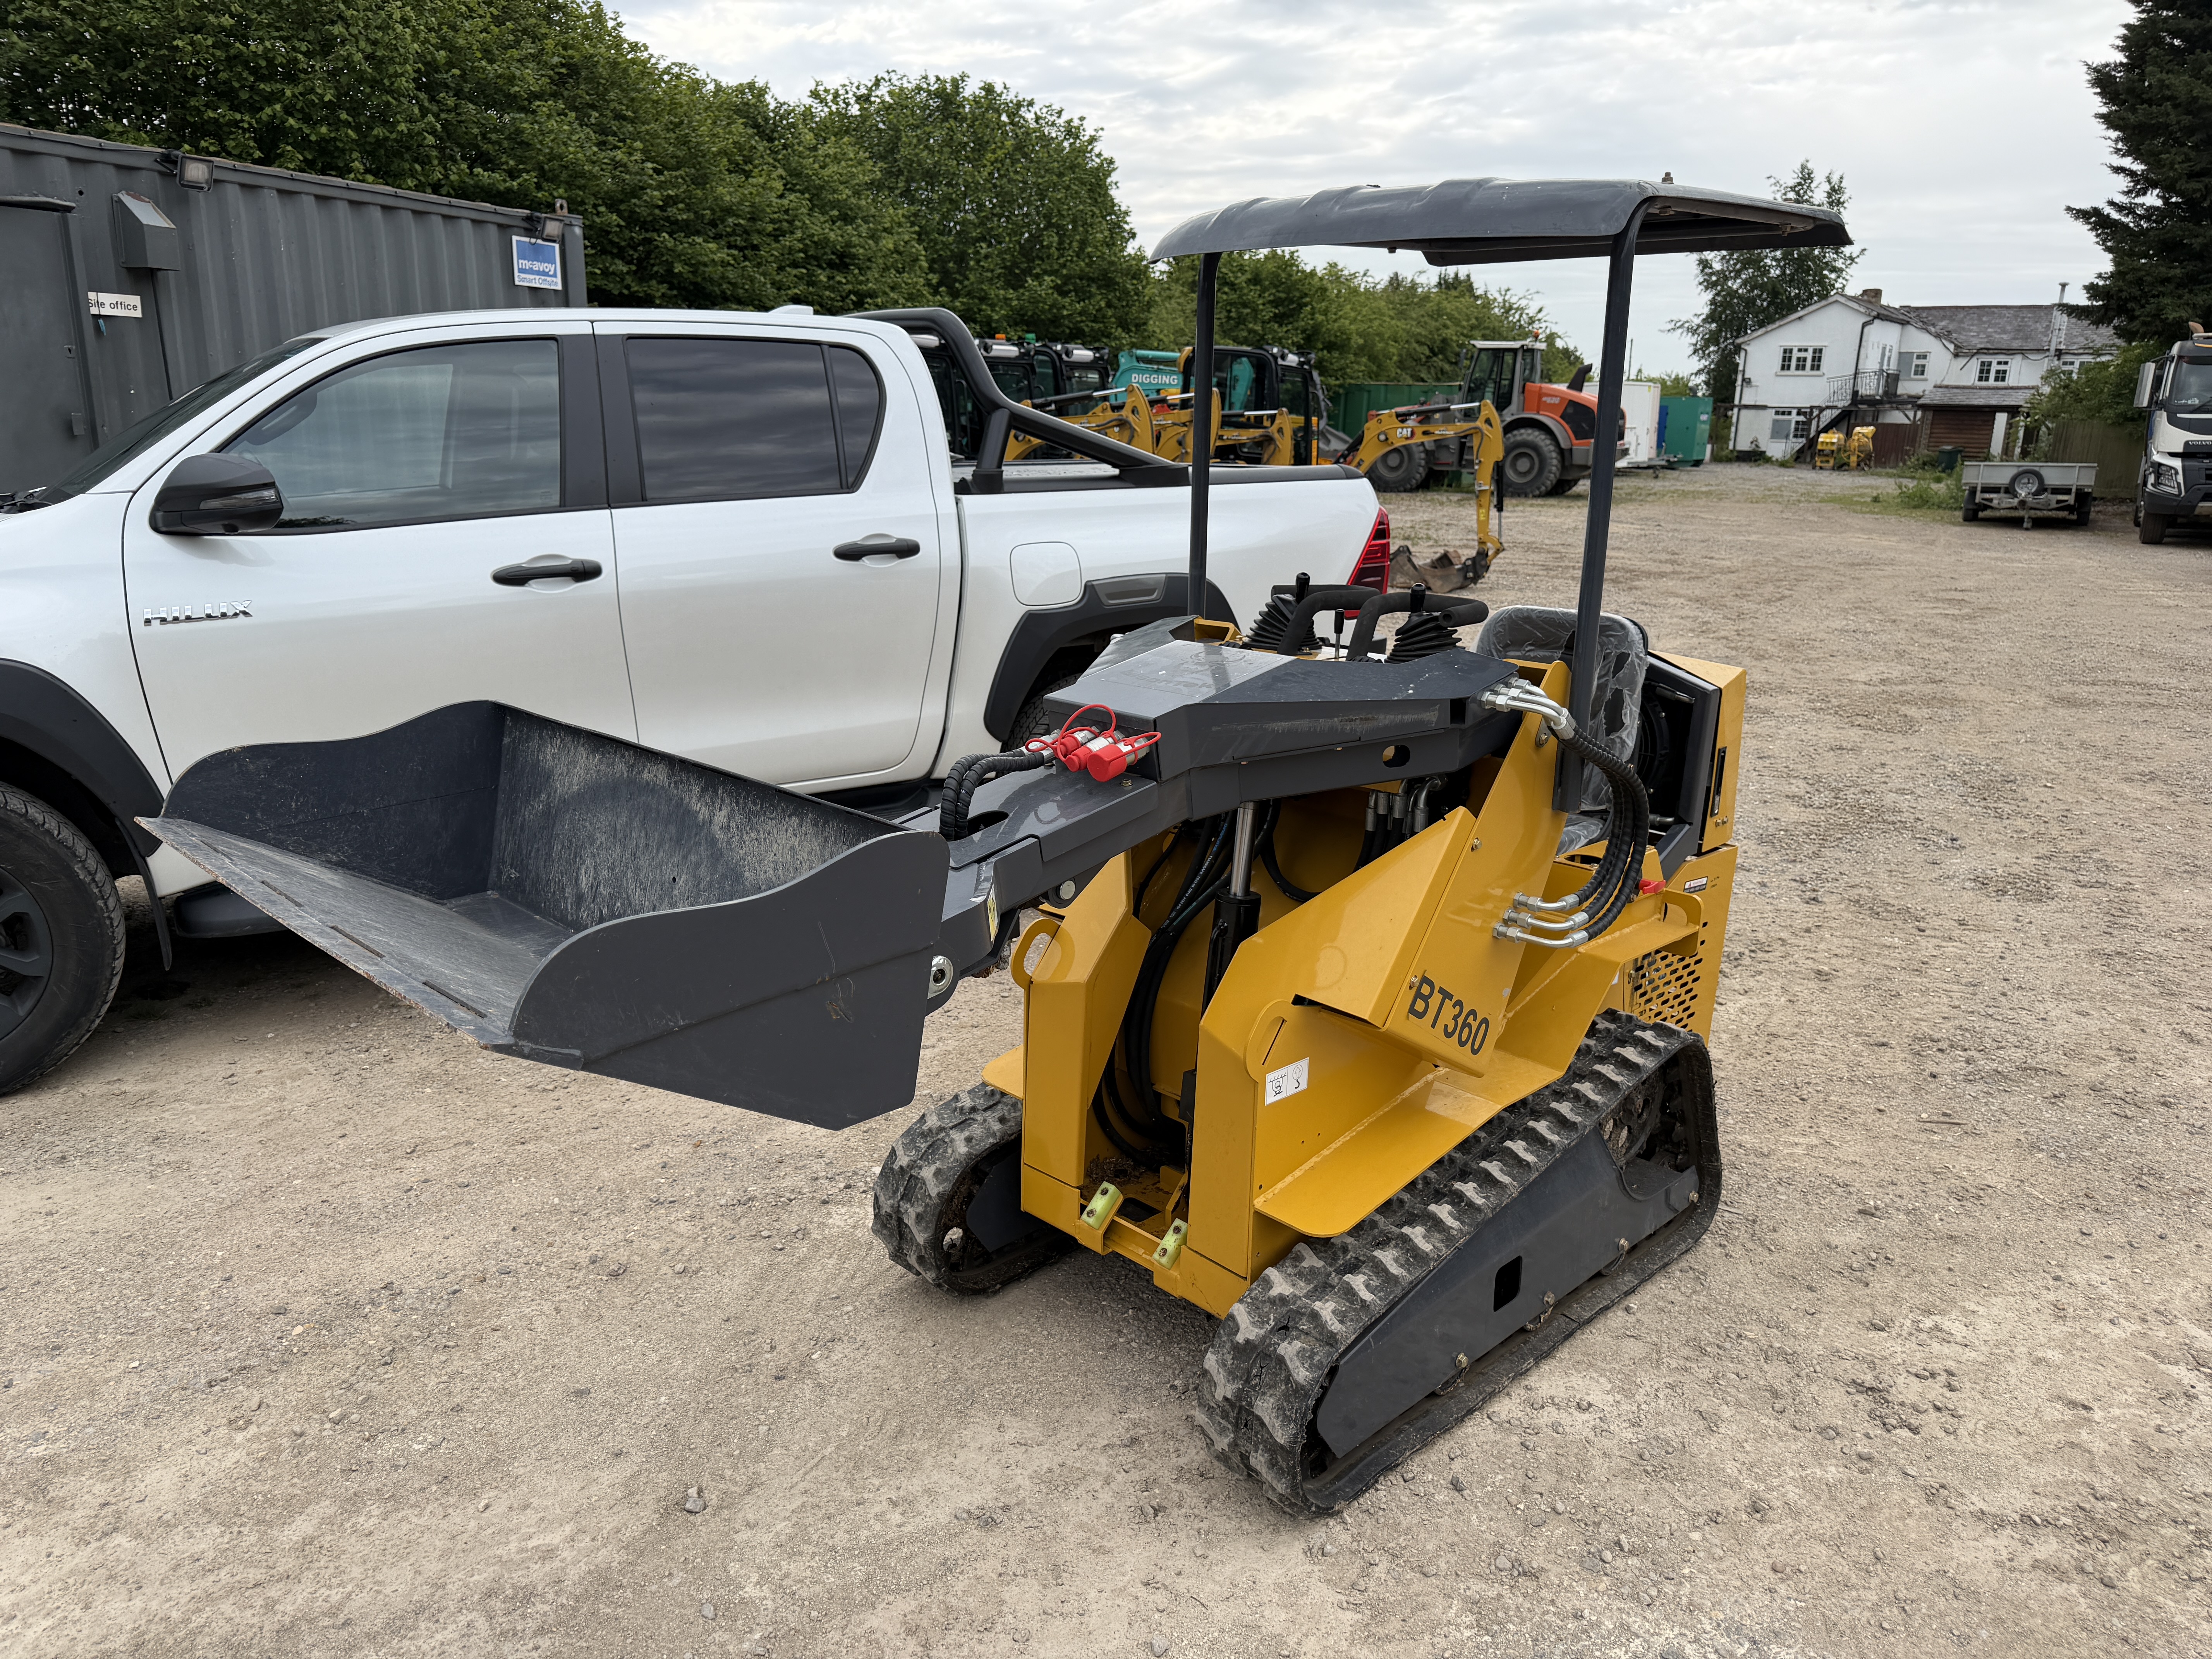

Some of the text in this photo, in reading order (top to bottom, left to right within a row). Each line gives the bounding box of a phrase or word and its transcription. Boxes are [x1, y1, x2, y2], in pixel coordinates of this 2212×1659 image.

[519, 259, 555, 275] mcavoy
[89, 299, 137, 311] Site office
[1132, 374, 1178, 385] DIGGING
[1396, 428, 1412, 438] CAT
[144, 600, 253, 626] HILUX
[1408, 975, 1489, 1056] BT360
